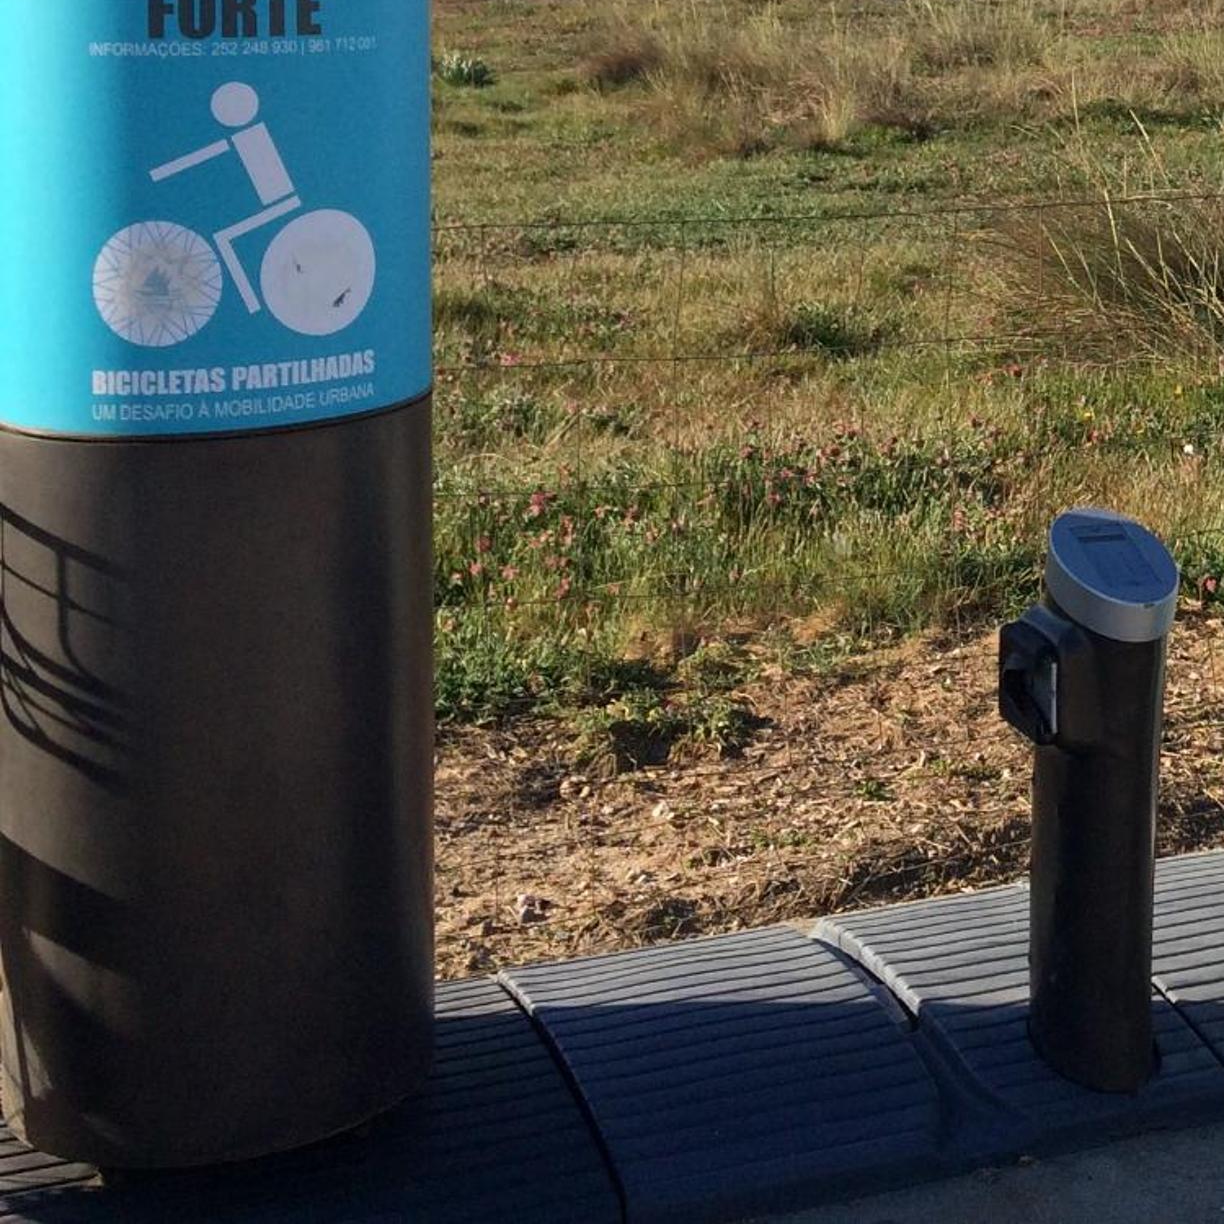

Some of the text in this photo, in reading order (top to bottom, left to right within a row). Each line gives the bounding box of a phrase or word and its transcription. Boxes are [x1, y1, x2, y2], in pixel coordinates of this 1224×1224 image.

[92, 349, 375, 396] BICICLETAS PARTILHADAS
[92, 403, 116, 421] UM
[120, 402, 194, 421] DESAFIO
[214, 391, 315, 417] MOBILIDADE
[319, 382, 375, 405] URBANA
